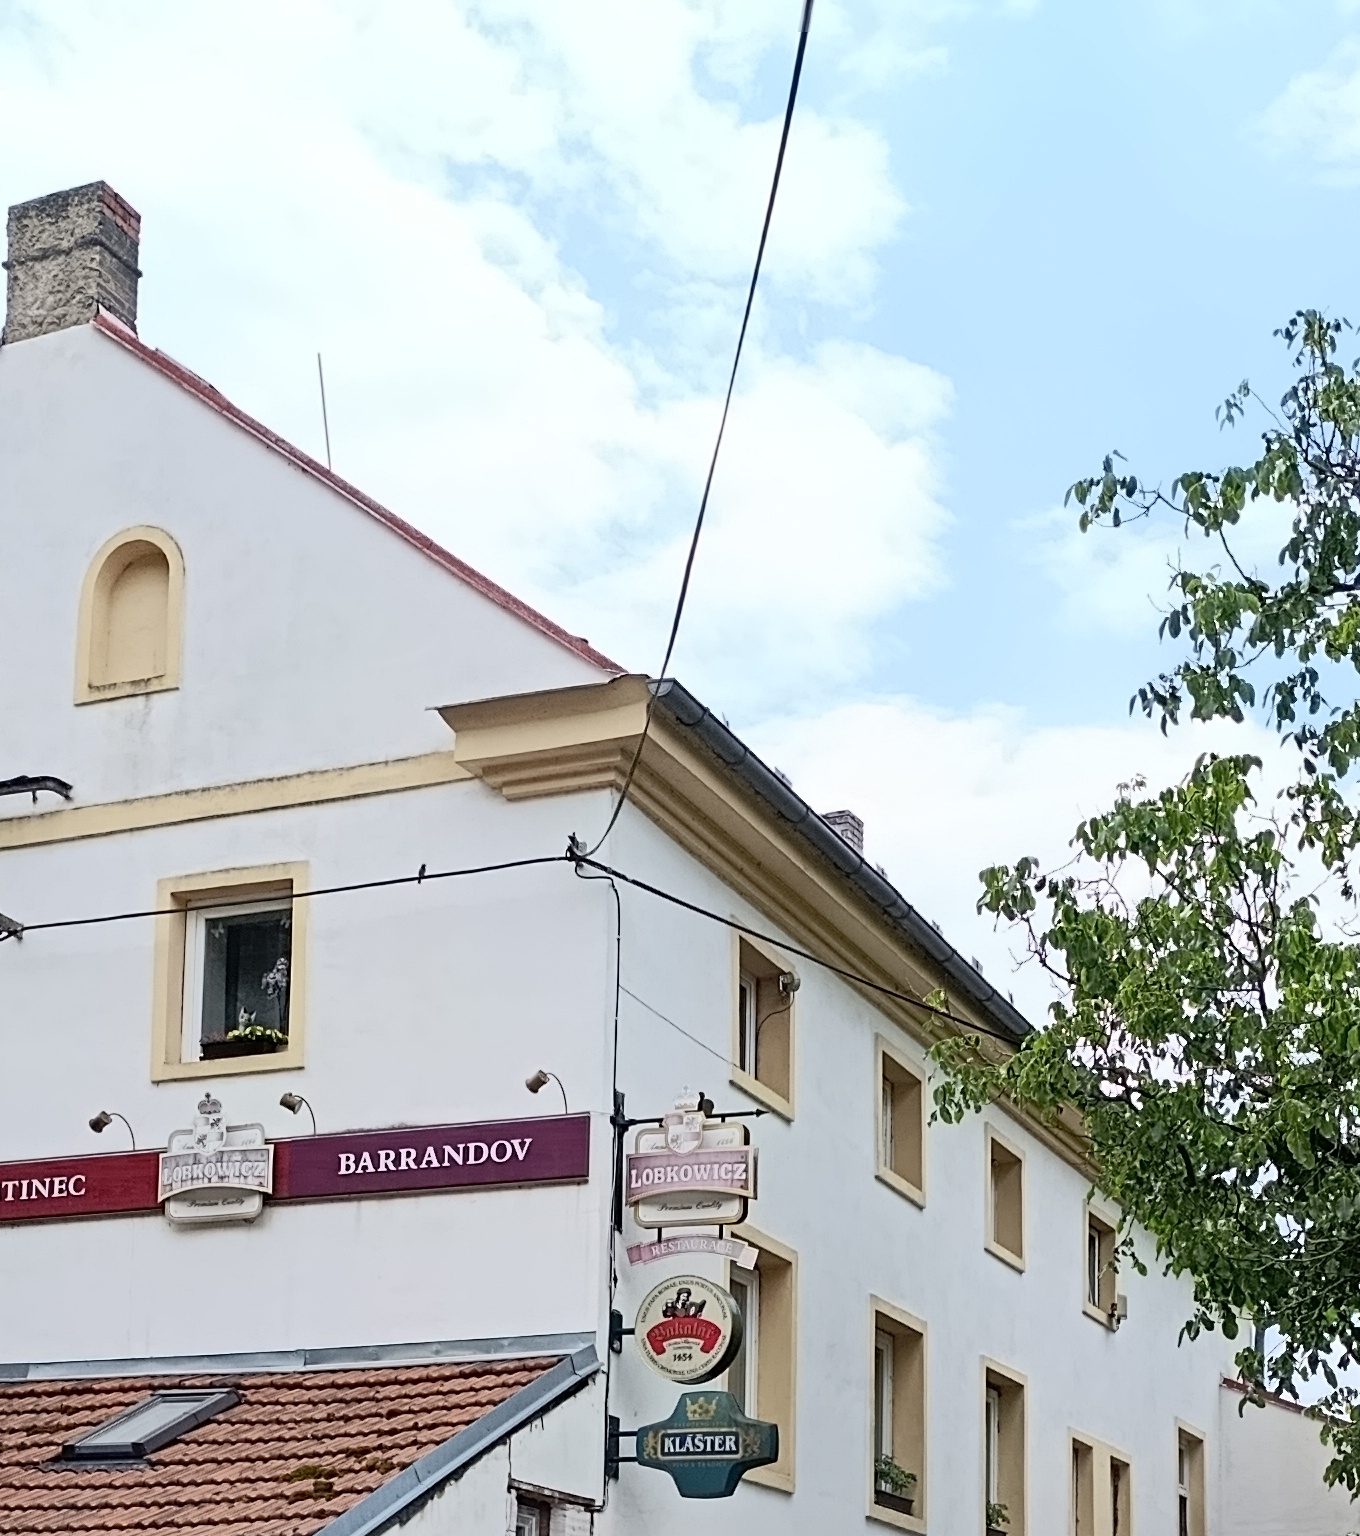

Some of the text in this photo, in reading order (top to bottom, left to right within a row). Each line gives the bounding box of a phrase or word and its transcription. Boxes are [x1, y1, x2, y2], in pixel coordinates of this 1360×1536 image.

[338, 1138, 533, 1175] BARRANDOV
[162, 1160, 266, 1186] LOBKOWICZ
[630, 1162, 747, 1189] LOBKOWICZ
[657, 1200, 723, 1212] Premium Quality
[651, 1239, 733, 1256] RESTAURACE
[650, 1321, 717, 1342] Bakalář
[673, 1352, 693, 1363] 1454
[664, 1433, 737, 1453] KLÁŠTER
